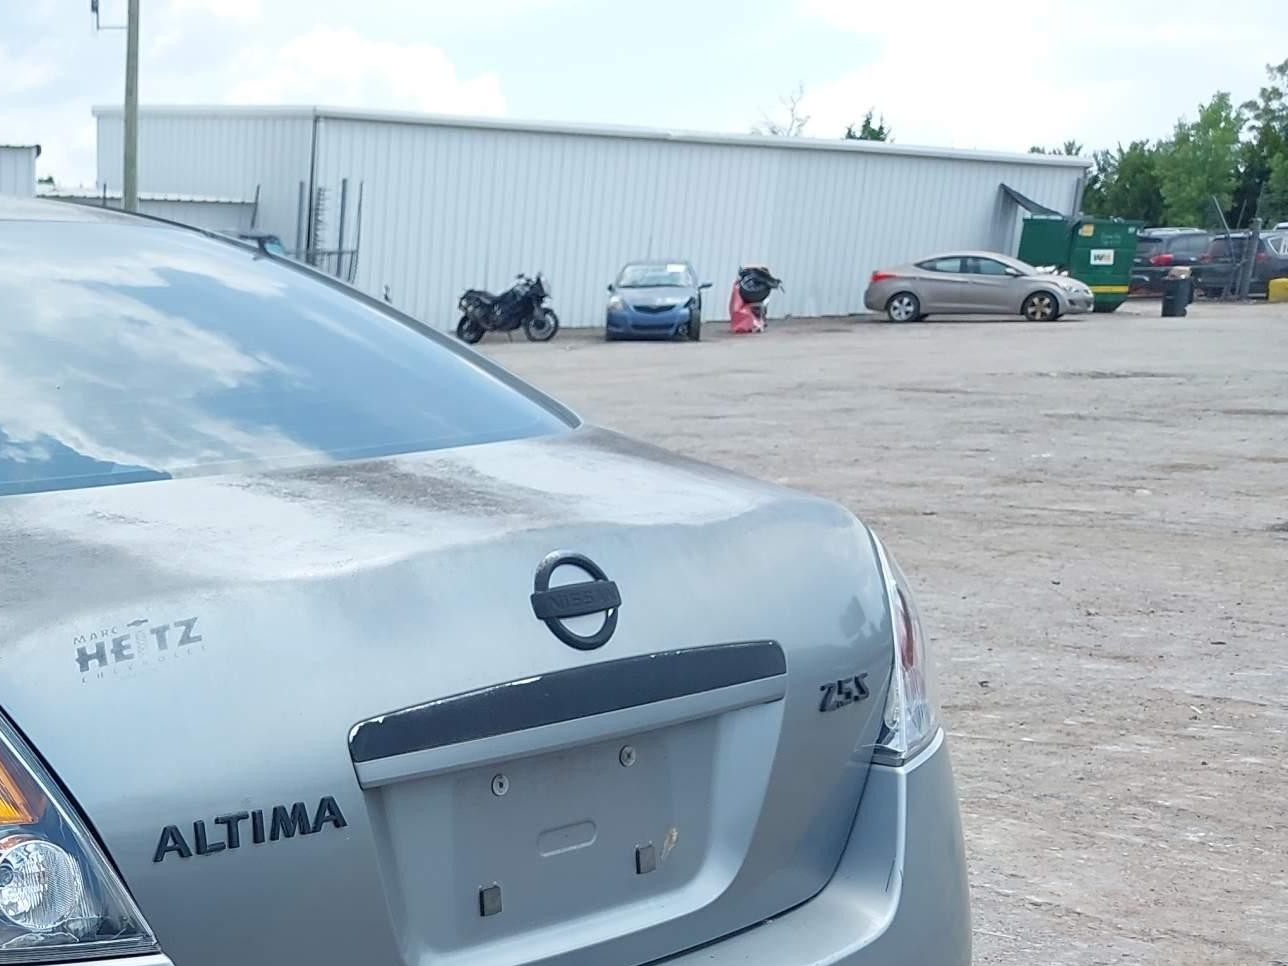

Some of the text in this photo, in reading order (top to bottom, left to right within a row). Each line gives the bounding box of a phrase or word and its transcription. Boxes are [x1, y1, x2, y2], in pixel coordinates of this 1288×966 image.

[549, 587, 615, 610] NISS
[75, 616, 203, 673] HETZ
[153, 795, 348, 863] ALTIMA
